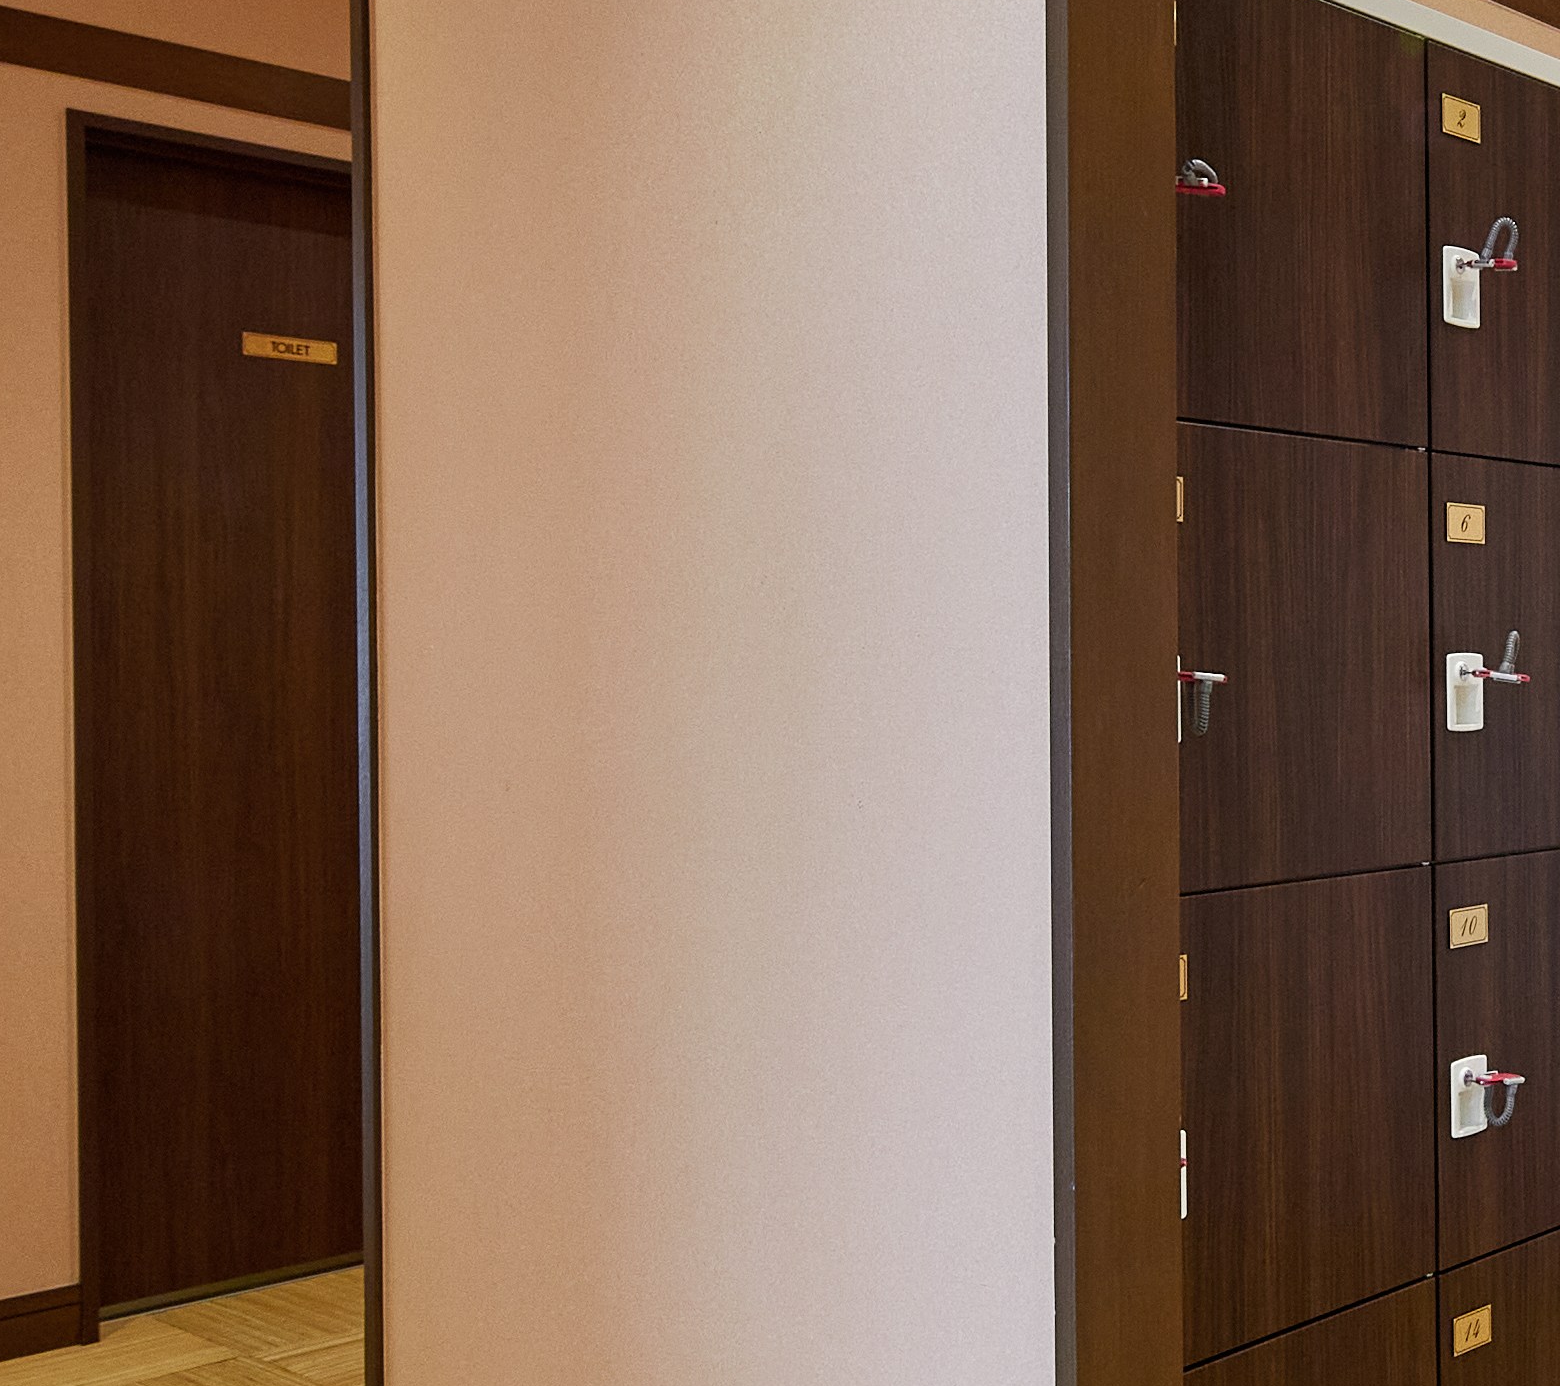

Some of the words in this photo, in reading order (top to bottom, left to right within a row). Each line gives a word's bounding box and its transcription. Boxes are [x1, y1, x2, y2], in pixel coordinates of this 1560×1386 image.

[270, 341, 310, 356] TOILET
[1460, 915, 1478, 937] 10
[1464, 1318, 1481, 1343] 14
